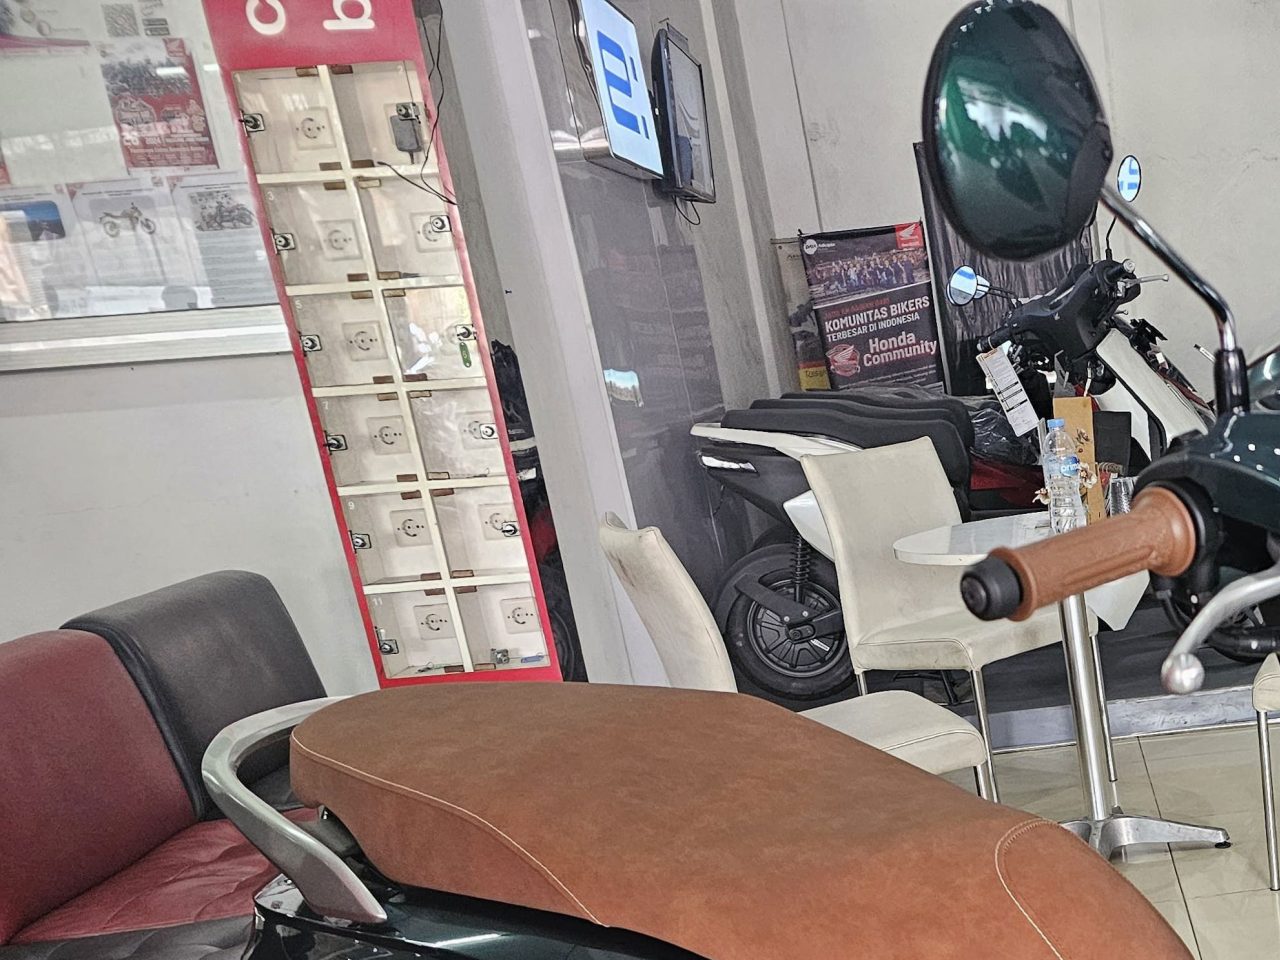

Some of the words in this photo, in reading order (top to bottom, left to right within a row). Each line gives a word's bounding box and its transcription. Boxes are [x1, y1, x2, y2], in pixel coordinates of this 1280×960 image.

[825, 306, 888, 333] KOMUNITAS
[890, 295, 930, 319] BIKERS
[826, 324, 869, 343] TERBESAR
[869, 322, 878, 333] DI
[878, 312, 921, 330] INDONESIA
[863, 340, 937, 367] Community
[869, 331, 916, 353] Honda
